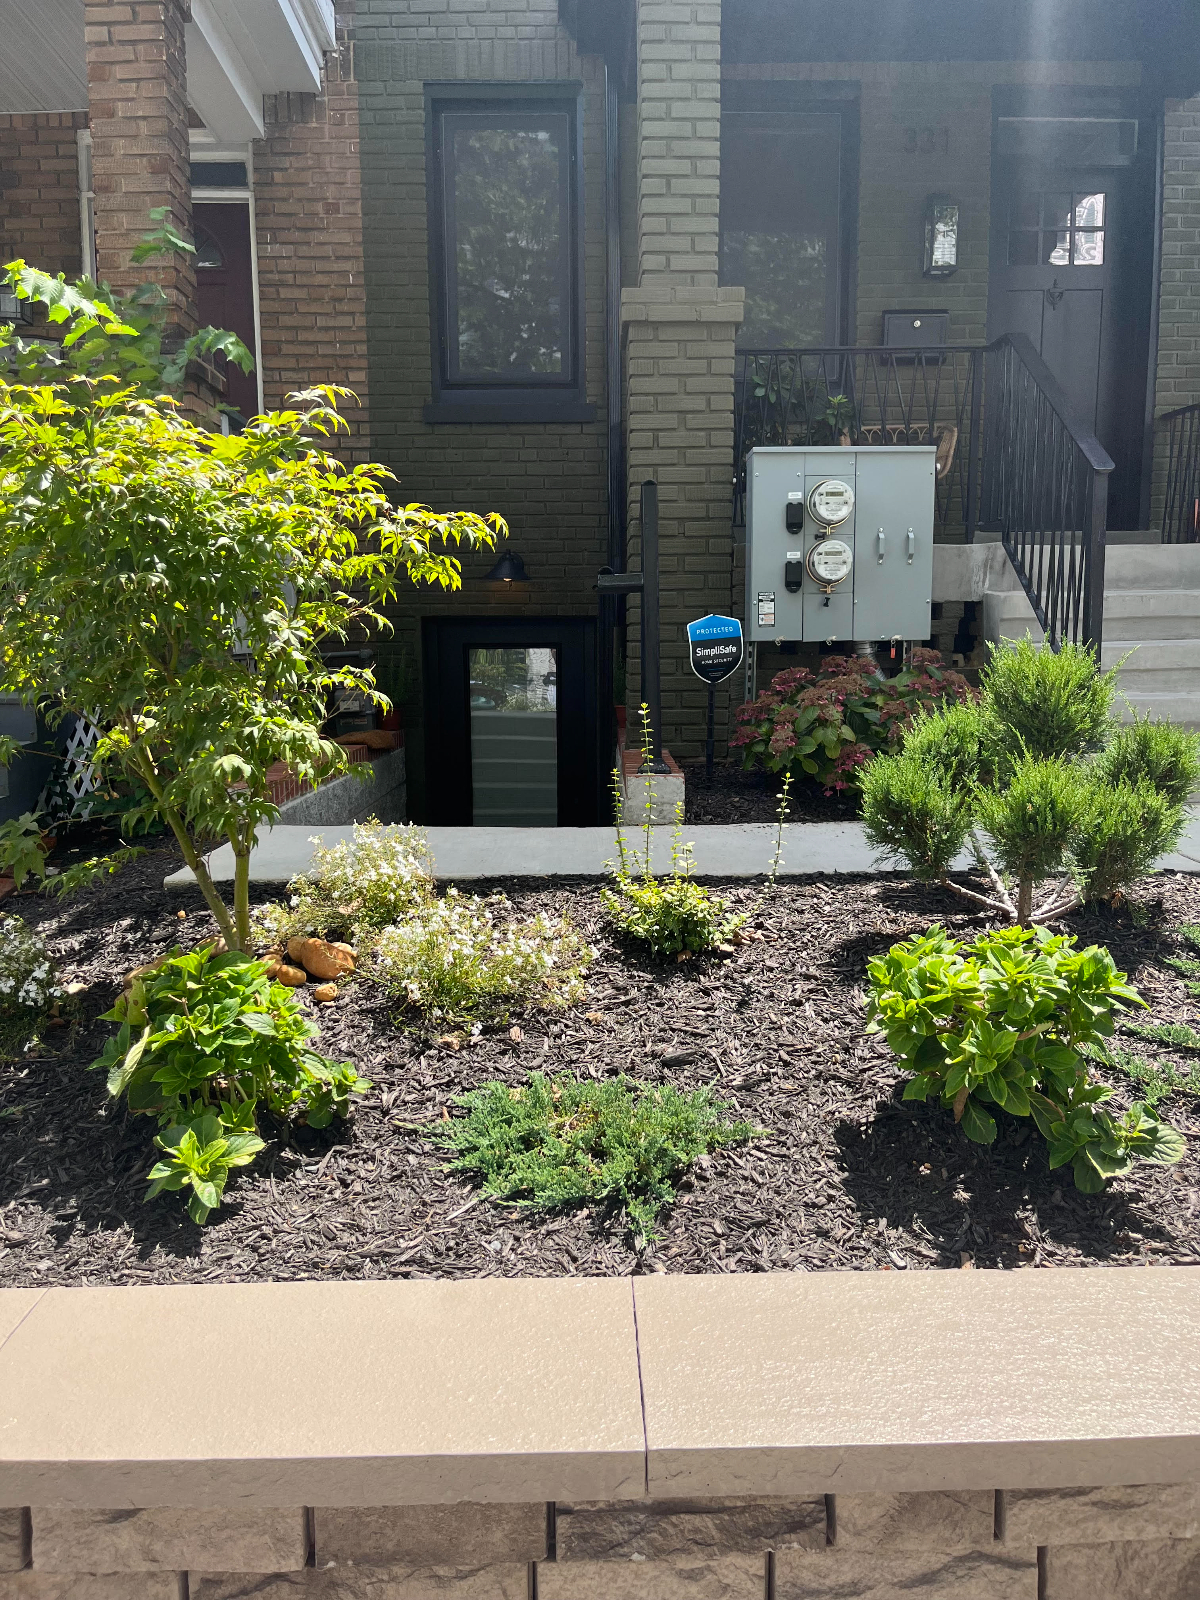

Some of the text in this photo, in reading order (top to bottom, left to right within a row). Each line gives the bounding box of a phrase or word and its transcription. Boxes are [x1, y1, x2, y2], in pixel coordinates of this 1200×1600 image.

[902, 127, 950, 155] 331
[696, 626, 733, 634] PROTECTED
[696, 645, 736, 656] SimpliSafe
